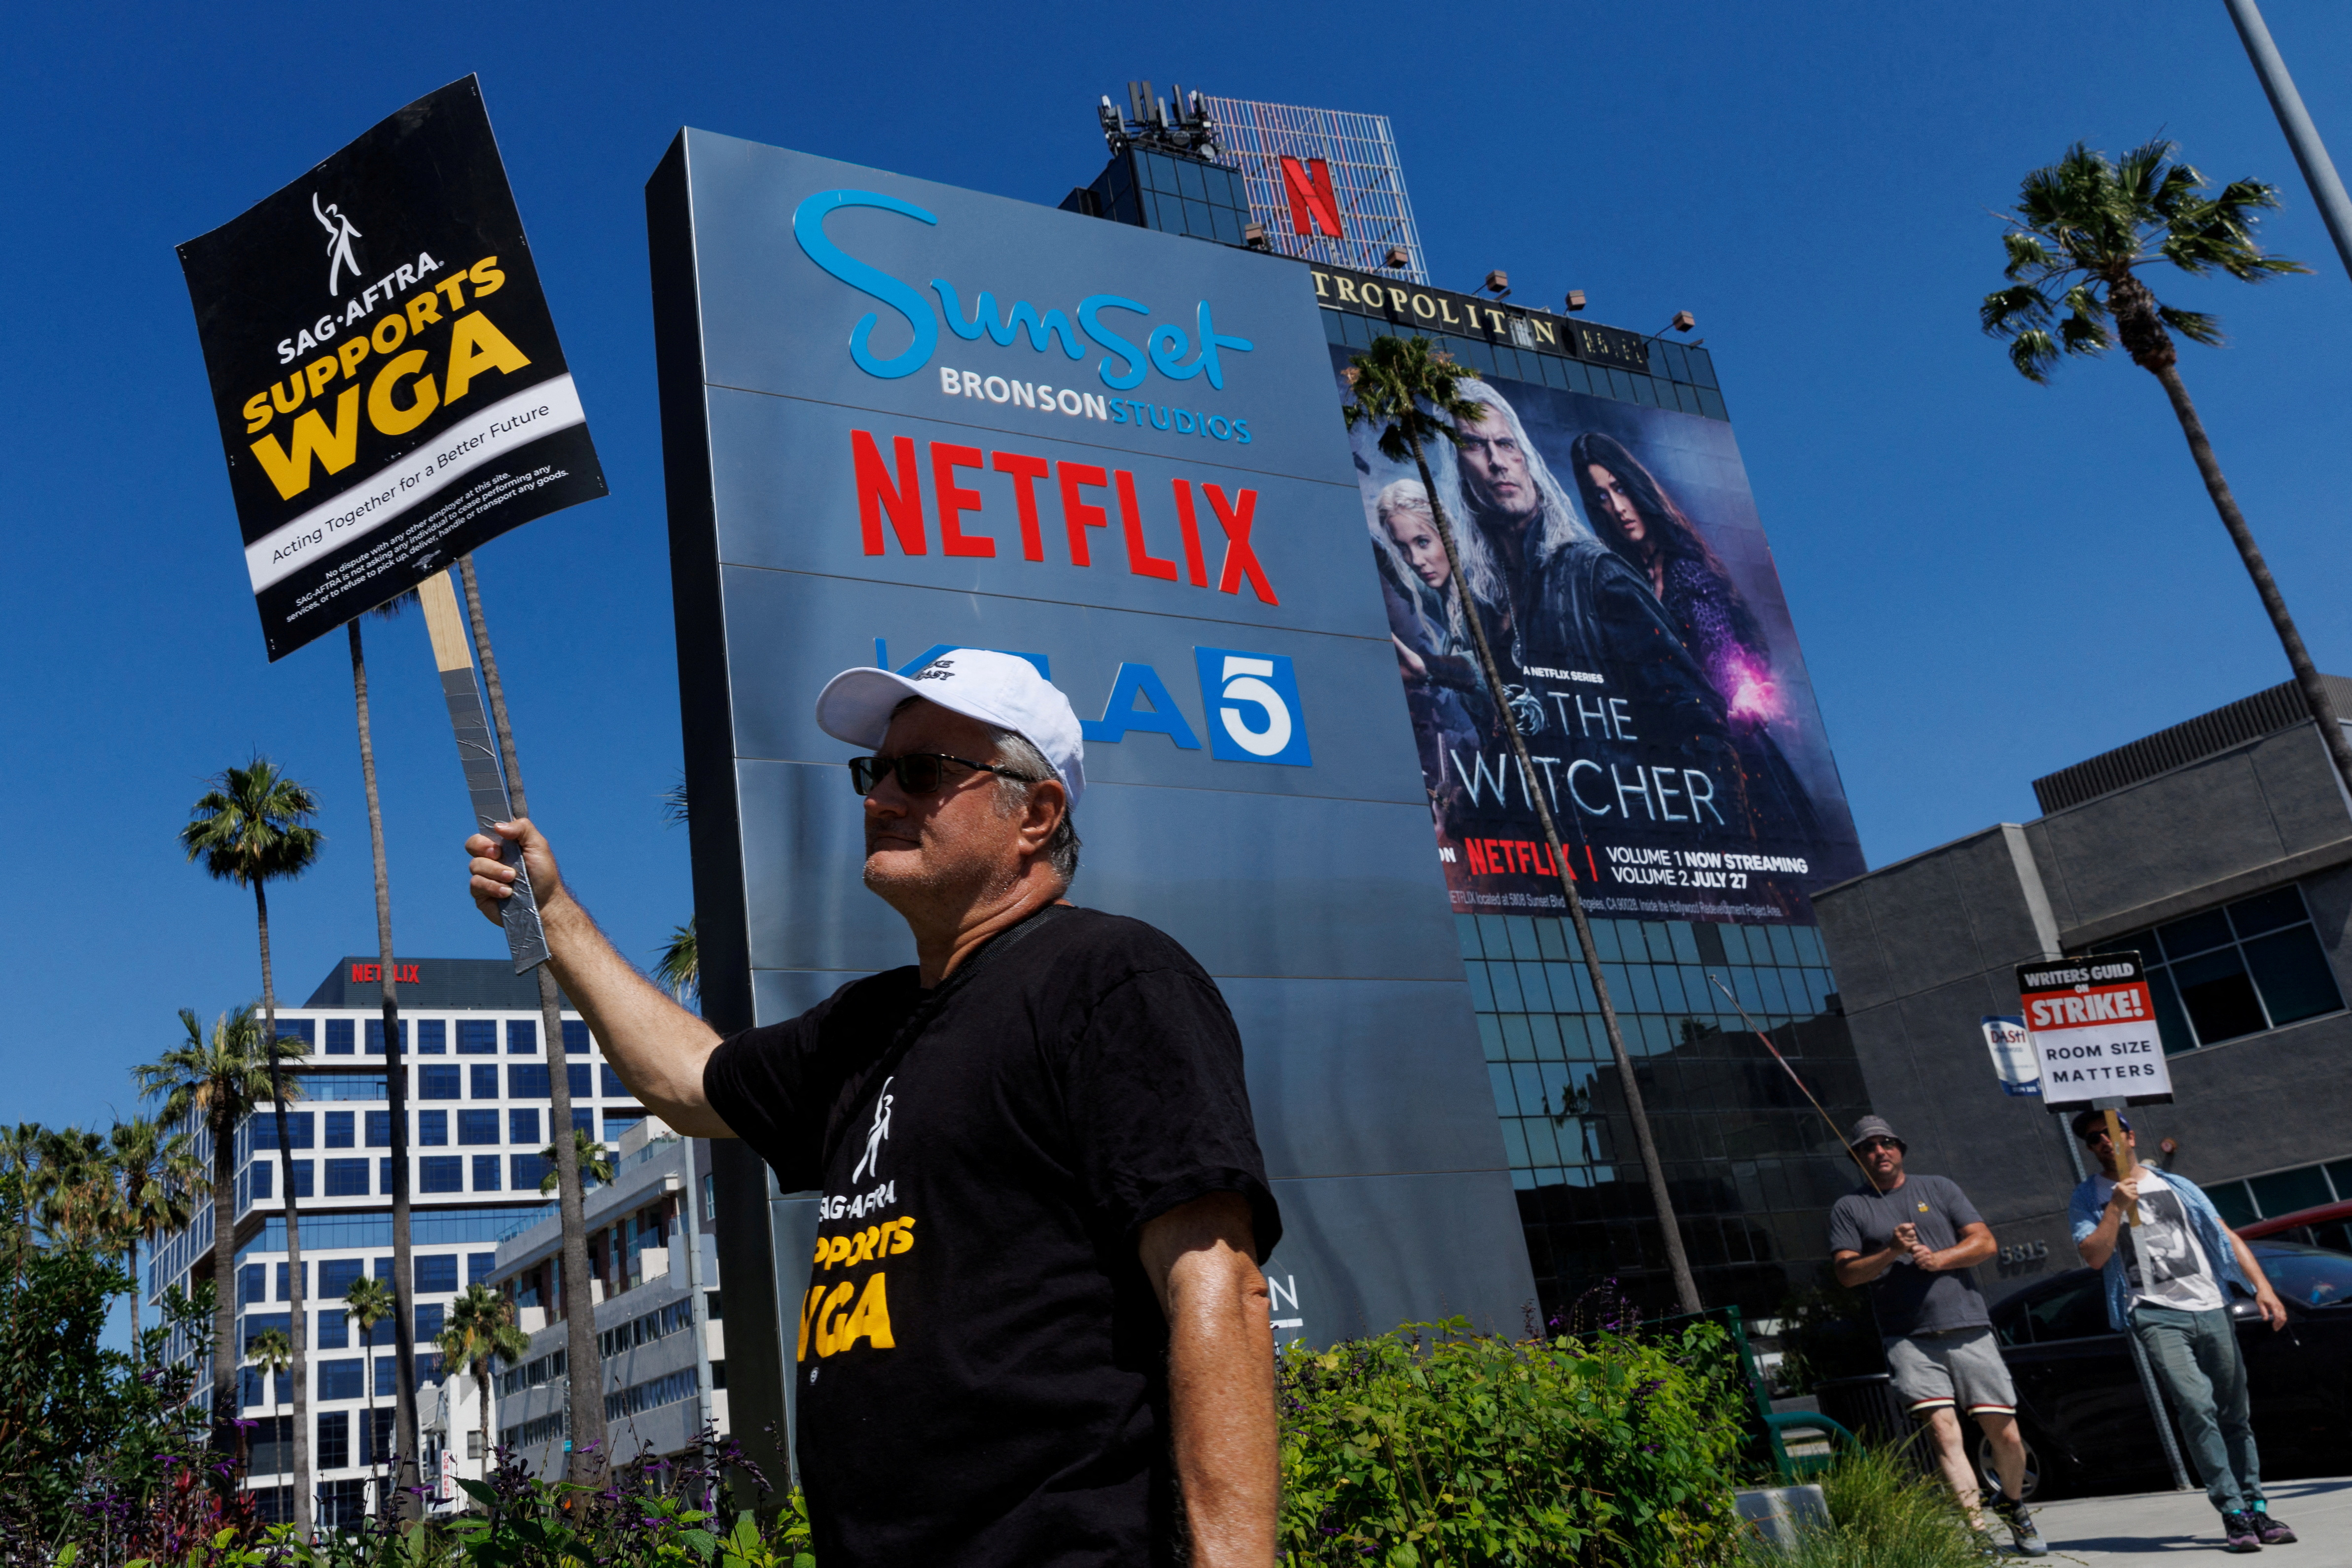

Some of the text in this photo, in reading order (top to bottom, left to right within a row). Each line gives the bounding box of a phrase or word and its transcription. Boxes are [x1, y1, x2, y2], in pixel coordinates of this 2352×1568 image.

[793, 189, 1253, 390] SunSet
[243, 255, 505, 434] SUPPORTS
[250, 310, 532, 501] WGA
[939, 367, 1251, 443] BRONSON STUDIOS
[273, 405, 550, 564] Acting Together for a Better Future
[296, 578, 342, 606] SAG-AFTRA
[351, 565, 365, 577] not
[366, 550, 393, 568] asking
[394, 541, 409, 553] any
[409, 518, 448, 543] individual
[448, 511, 457, 520] to
[458, 497, 481, 514] cease
[482, 472, 533, 502] performing
[533, 465, 551, 477] any
[325, 472, 511, 579] No dispute with any other employer at this site.
[850, 429, 1279, 606] NETFLIX
[286, 600, 320, 623] services,
[320, 594, 329, 603] or
[330, 589, 339, 597] to
[340, 575, 366, 592] refuse
[367, 569, 376, 578] to
[377, 558, 395, 575] pick
[395, 552, 409, 563] up,
[409, 533, 439, 555] deliver,
[438, 517, 465, 537] handle
[466, 511, 475, 520] or
[476, 489, 517, 513] transport
[518, 481, 535, 493] any
[536, 470, 569, 487] goods.
[1523, 666, 1604, 684] A NETFLIX SERIES
[1219, 656, 1291, 756] 5
[1547, 691, 1638, 740] THE
[1450, 749, 1725, 825] WITCHER
[1464, 837, 1577, 880] NETFLIX
[1606, 846, 1808, 873] VOLUME 1 NOW STREAMING
[1611, 867, 1747, 889] VOLUME 2 JULY 27
[1449, 890, 1474, 905] ETFLIX
[1476, 892, 1501, 906] located
[1502, 894, 1509, 906] at
[1527, 894, 1550, 907] Sunset
[1606, 897, 1618, 910] CA
[352, 964, 419, 983] NETLIX
[2025, 963, 2135, 987] WRITERS GUILD
[2074, 984, 2089, 993] ON
[2031, 988, 2144, 1027] STRIKE!
[1991, 1030, 2026, 1043] DASH
[2047, 1041, 2151, 1060] ROOM SIZE
[2053, 1064, 2155, 1083] MATTERS
